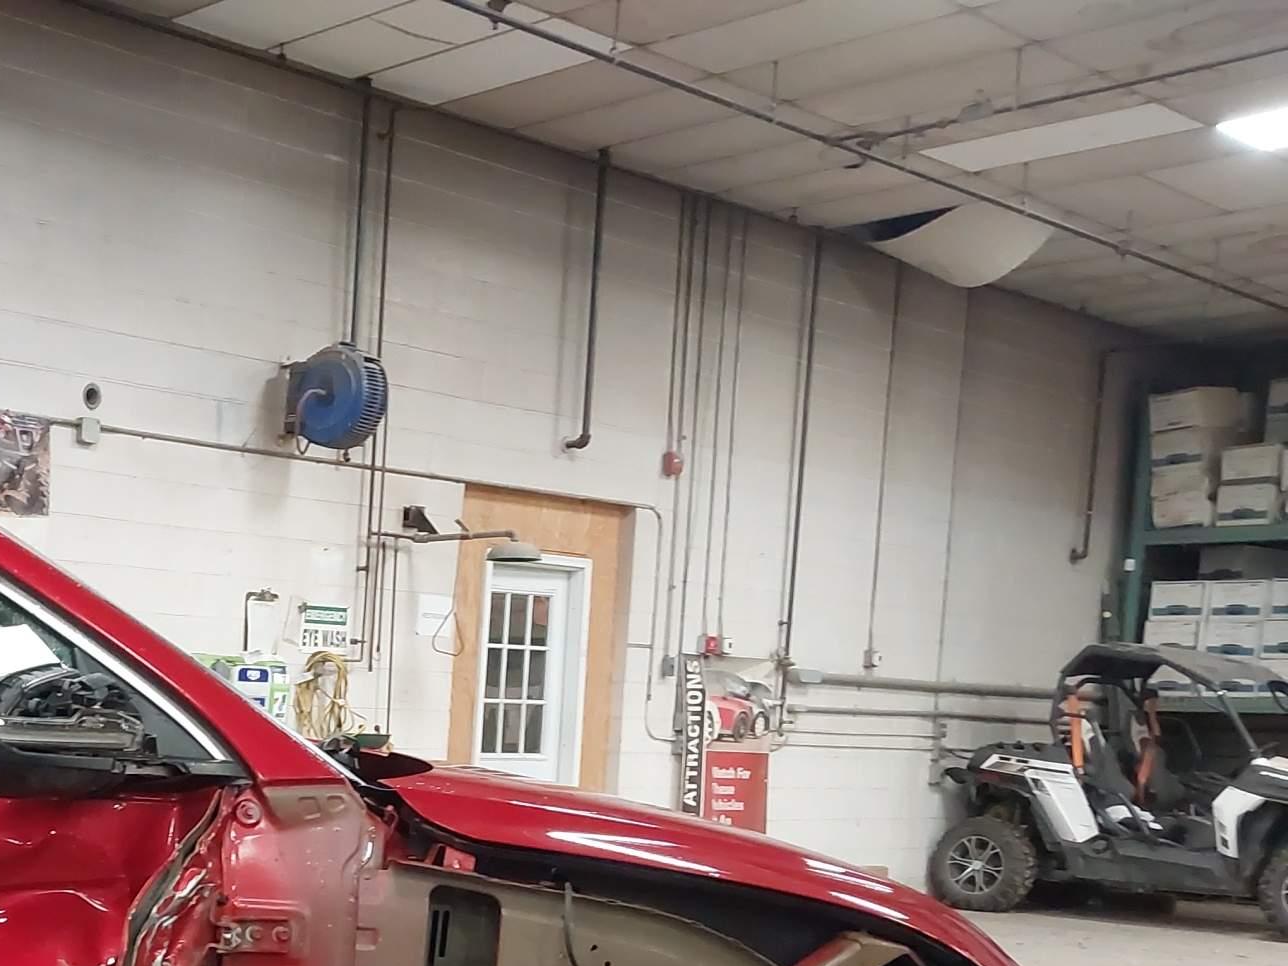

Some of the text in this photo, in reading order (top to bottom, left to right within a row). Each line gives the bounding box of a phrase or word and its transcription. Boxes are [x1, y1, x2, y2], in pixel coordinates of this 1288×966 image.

[303, 629, 347, 648] EYE WASH
[684, 659, 705, 808] ATTRACTIONS
